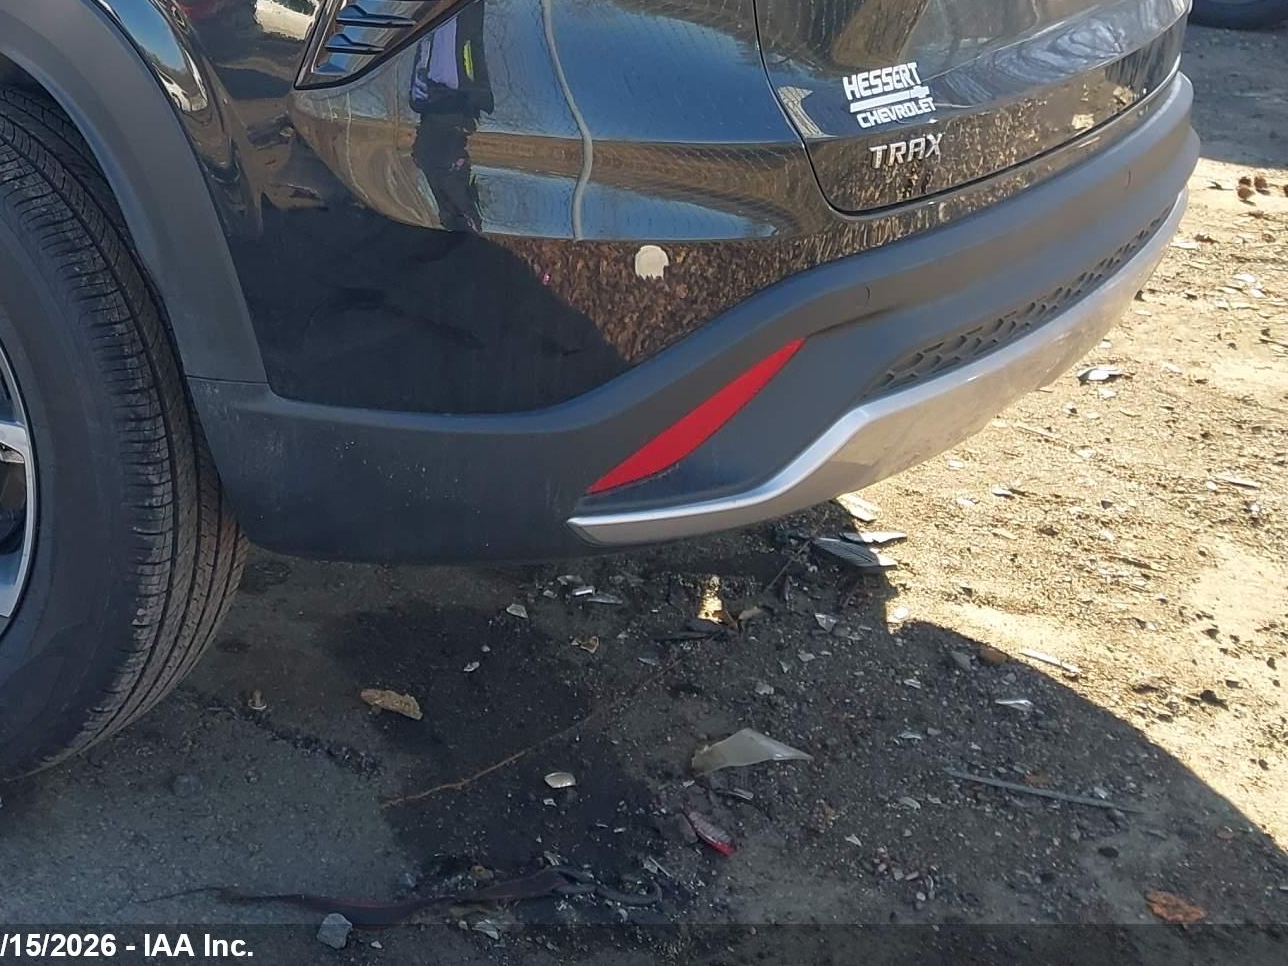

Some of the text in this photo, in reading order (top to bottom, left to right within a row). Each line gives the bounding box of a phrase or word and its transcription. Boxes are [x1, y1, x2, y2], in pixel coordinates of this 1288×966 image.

[843, 62, 922, 100] HESSERT
[857, 98, 937, 128] CHEVROLET
[869, 134, 943, 169] TRAX
